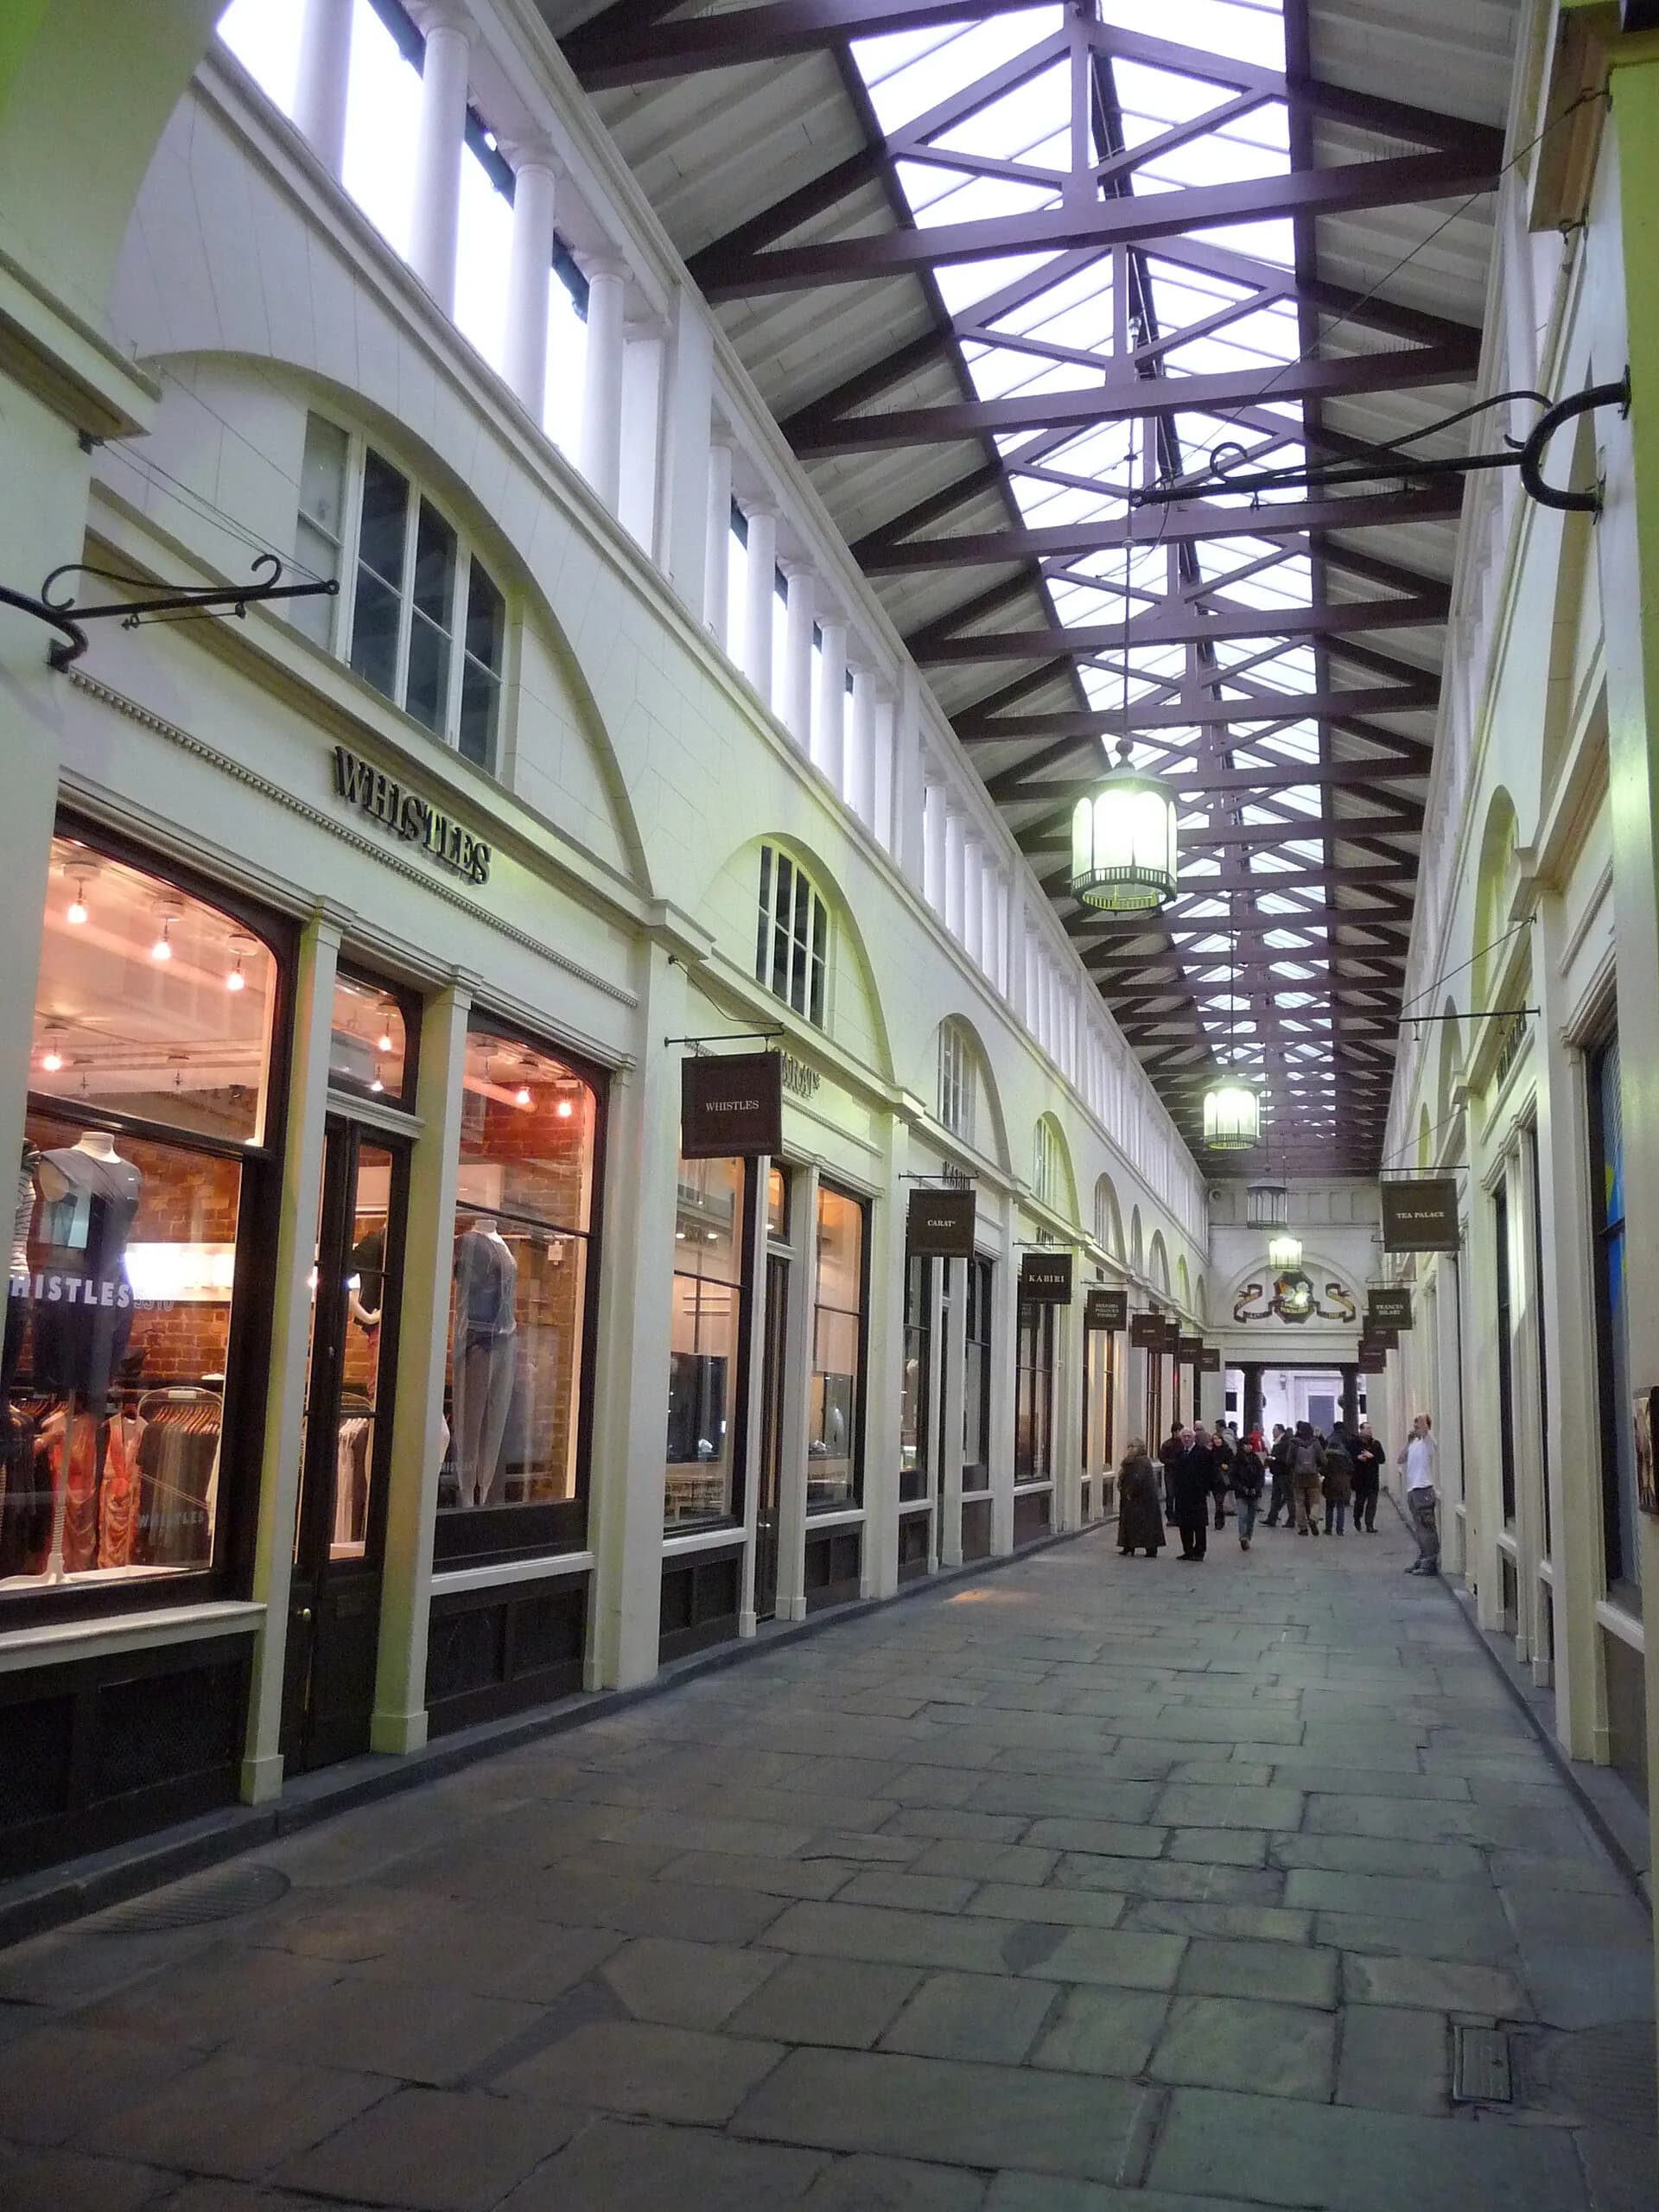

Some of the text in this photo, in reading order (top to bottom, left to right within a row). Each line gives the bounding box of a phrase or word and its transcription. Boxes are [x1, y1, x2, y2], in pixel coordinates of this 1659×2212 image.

[335, 746, 491, 884] WHISTLES
[706, 1100, 760, 1111] WHISTLES
[1029, 1274, 1065, 1283] KABIRI
